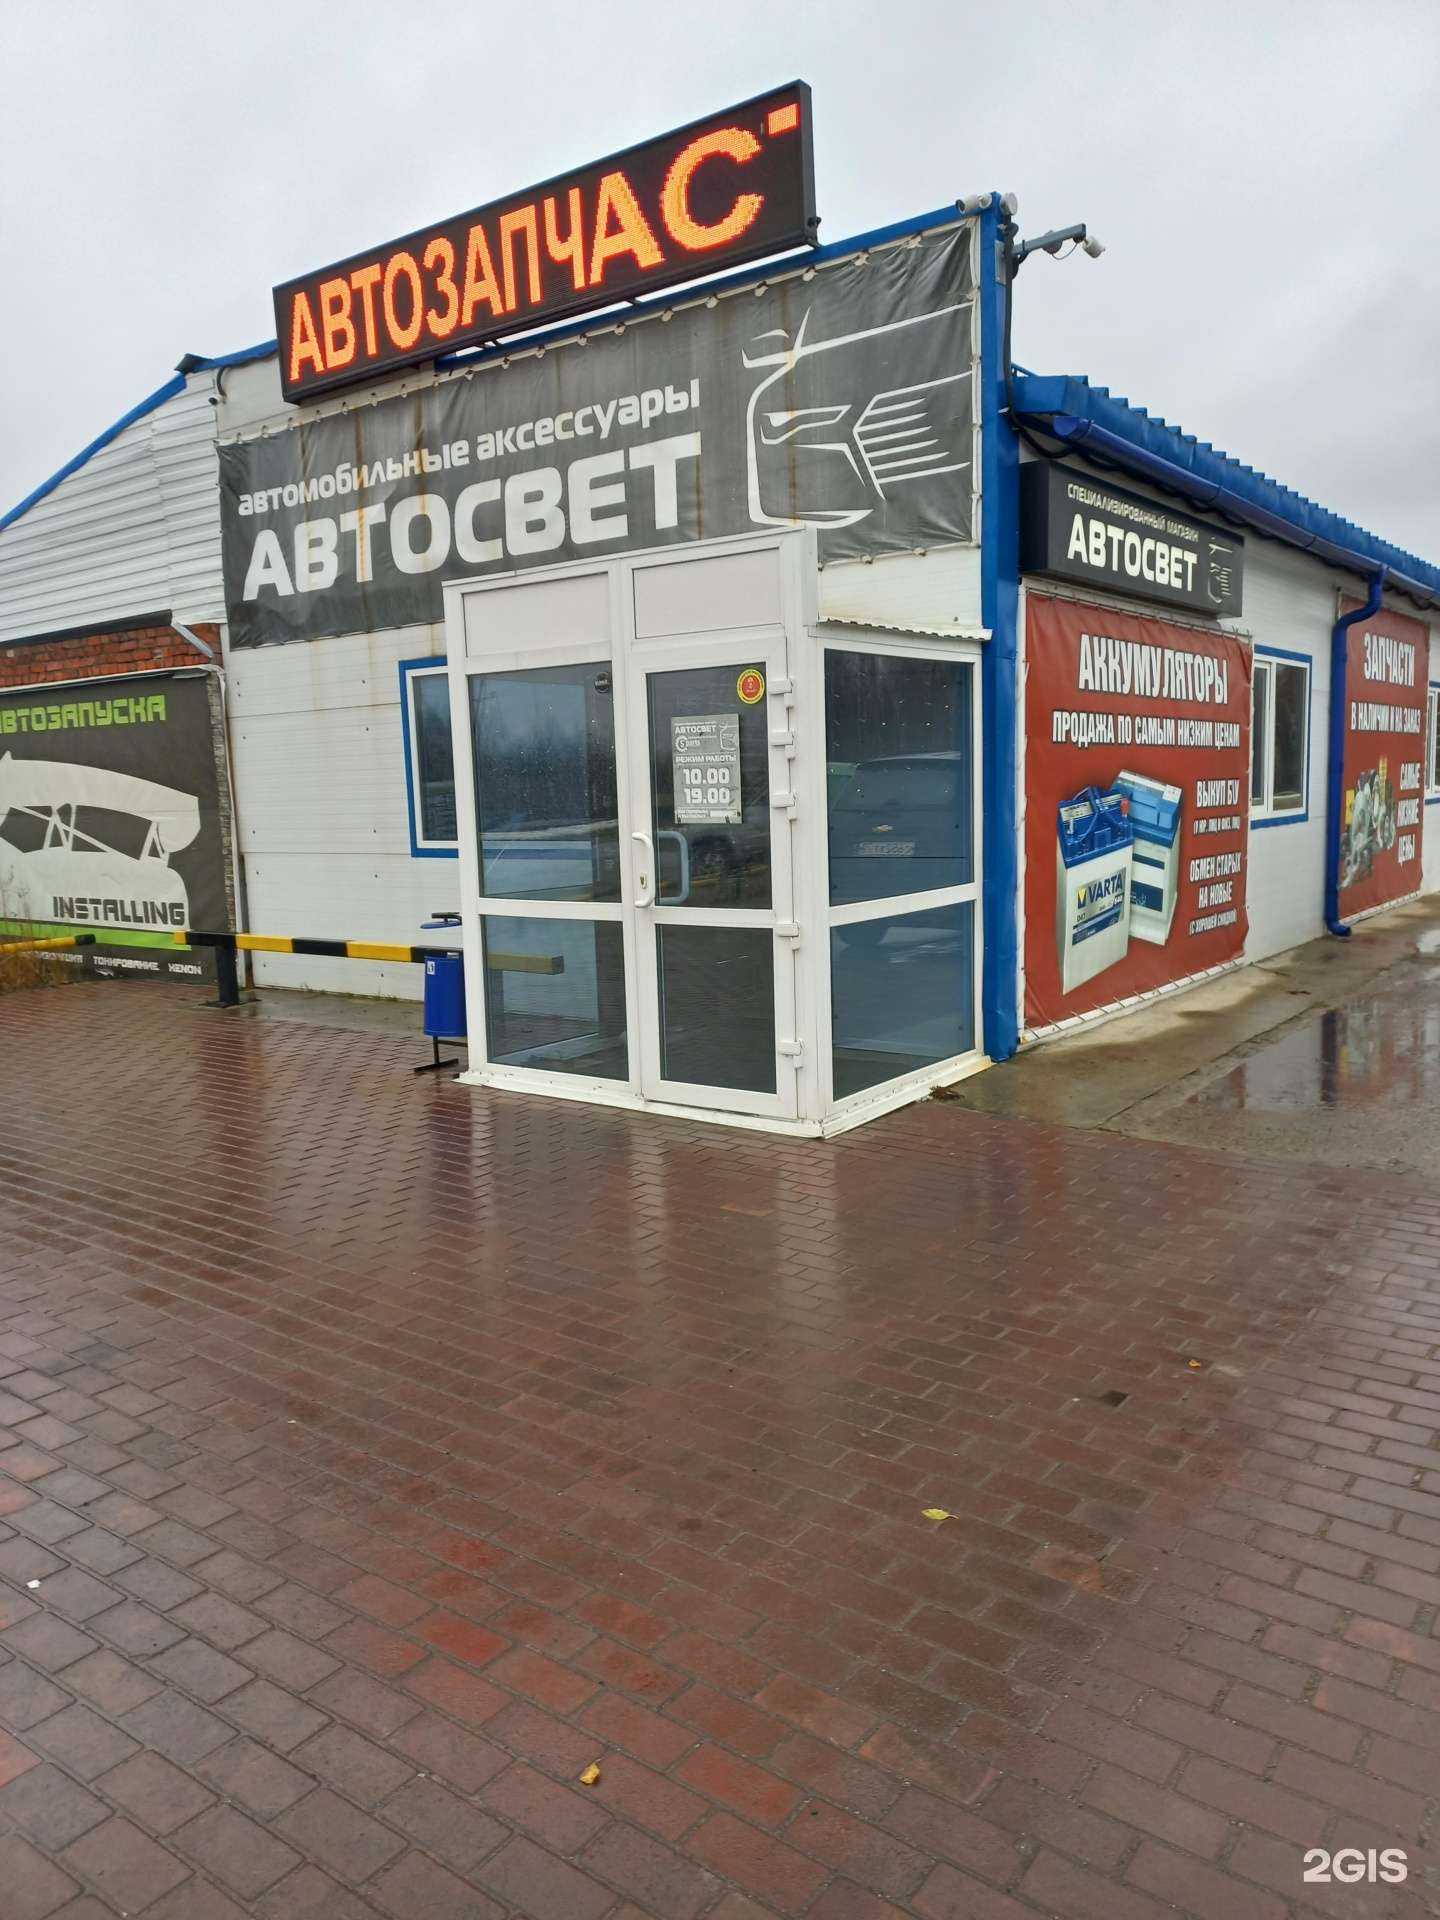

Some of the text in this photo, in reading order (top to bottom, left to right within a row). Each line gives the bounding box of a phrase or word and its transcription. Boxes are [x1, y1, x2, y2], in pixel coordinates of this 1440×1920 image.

[288, 103, 798, 382] АВТОЗАПЧАС
[238, 378, 701, 516] автомобильные аксессуары
[242, 431, 702, 602] АВТОСВЕТ
[1067, 513, 1198, 592] АВТОСВЕТ
[1078, 633, 1228, 705] АККУМУЛЯТОРЫ
[1363, 632, 1416, 687] ЗАПЧАСТИ
[0, 695, 167, 734] ВТОЗАПУСКА
[1052, 710, 1240, 750] ПРОДАЖА ПО САМЫМ НИЗКИМ ЦЕНАМ
[1351, 702, 1357, 730] В
[706, 754, 737, 762] РАБОТЫ
[683, 767, 730, 785] 10.00
[684, 787, 730, 804] 19.00
[1196, 779, 1226, 808] ВЫКУП
[1189, 852, 1241, 882] ОБМЕН СТАРЫХ
[1088, 873, 1123, 904] VARTA
[1199, 881, 1233, 909] НА НОВЫЕ
[53, 896, 185, 926] INSTALLING
